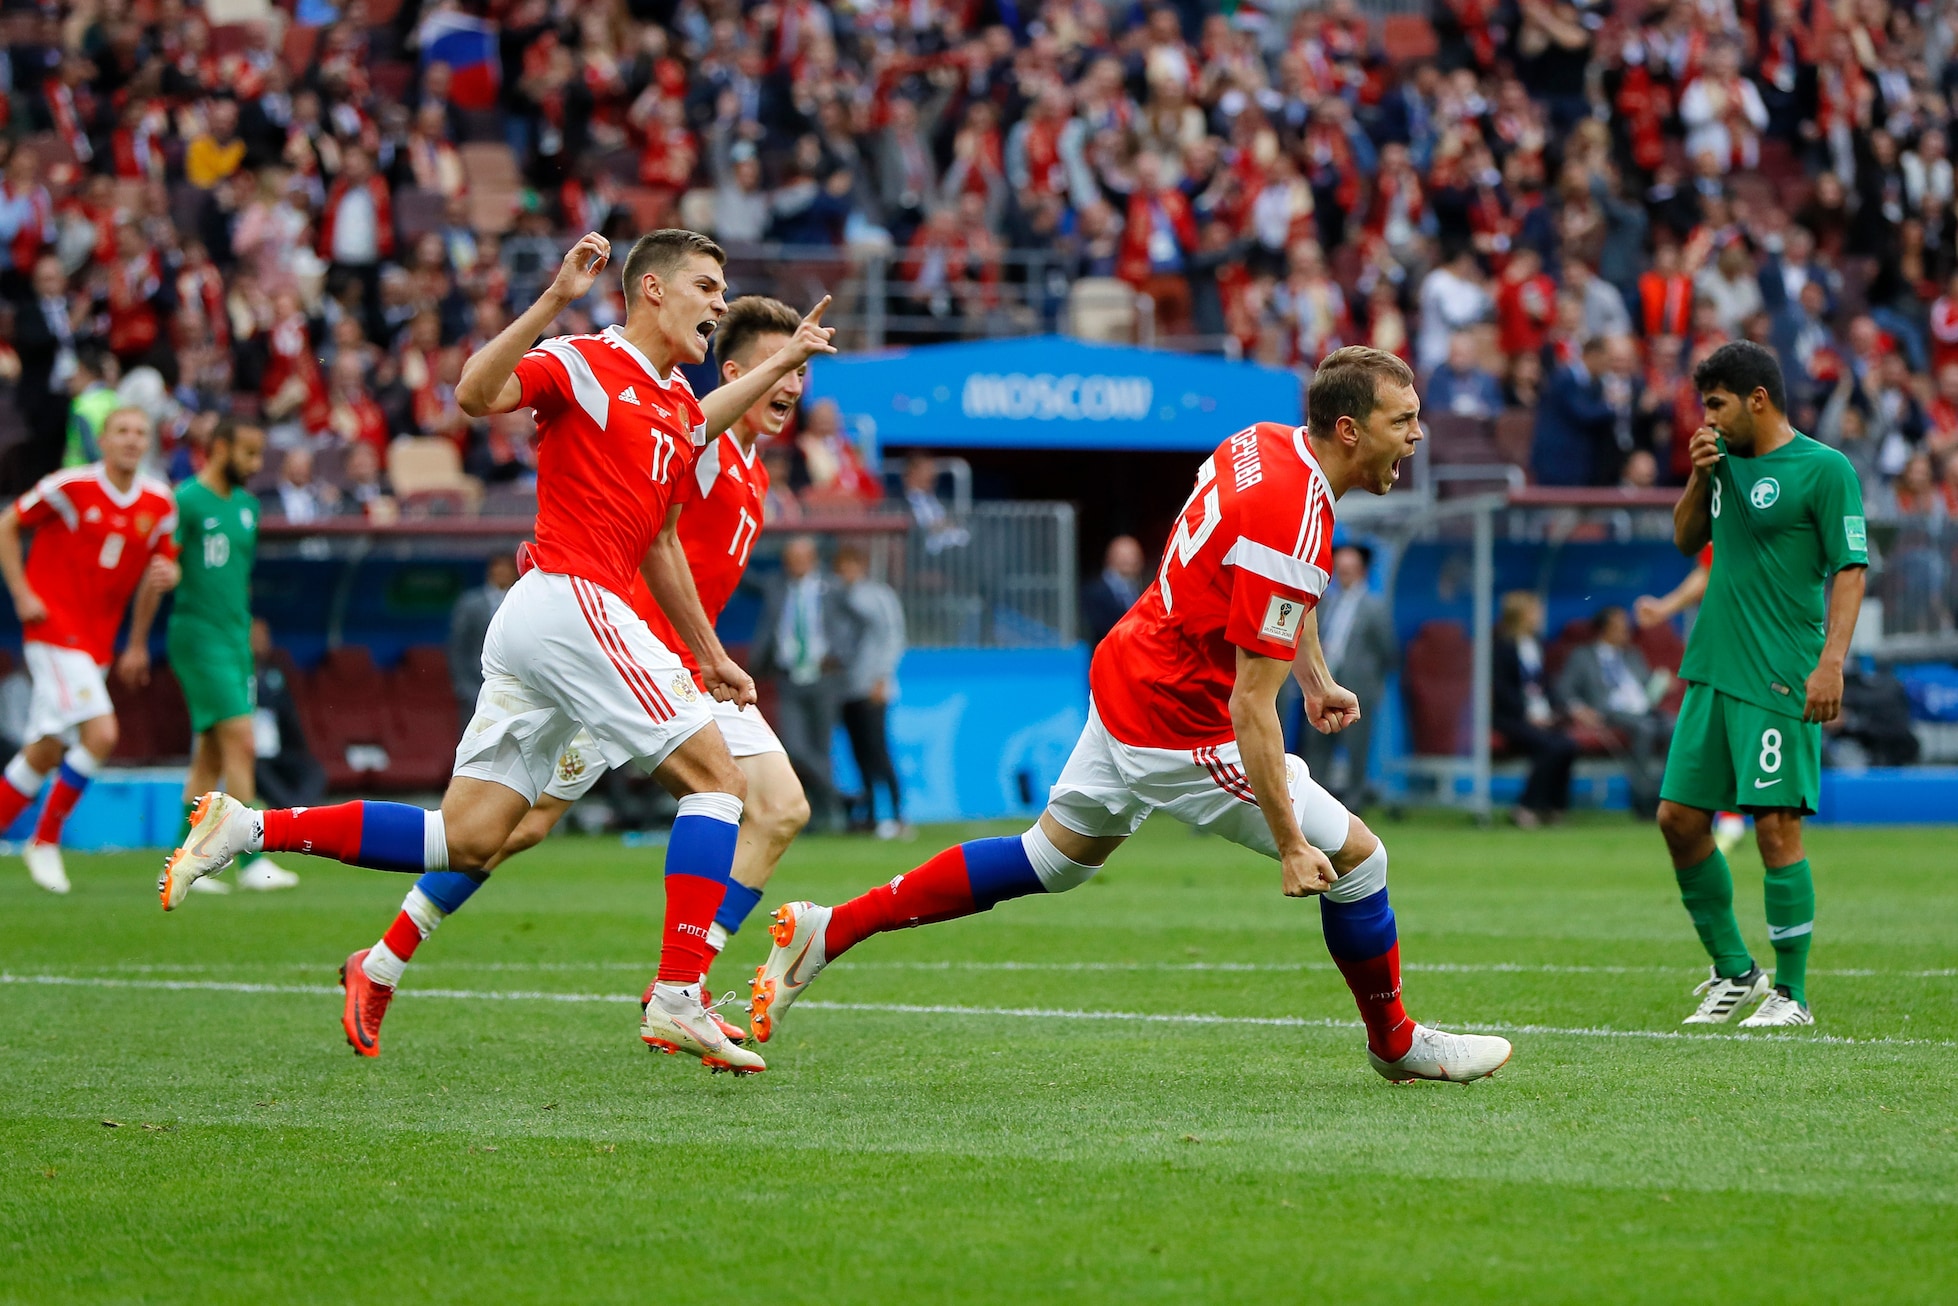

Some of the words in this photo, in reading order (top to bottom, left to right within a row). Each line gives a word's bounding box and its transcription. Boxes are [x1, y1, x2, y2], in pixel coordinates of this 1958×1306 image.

[962, 372, 1153, 421] MOSCOW
[203, 532, 230, 569] 10
[728, 506, 757, 566] 17
[1759, 727, 1782, 773] 8
